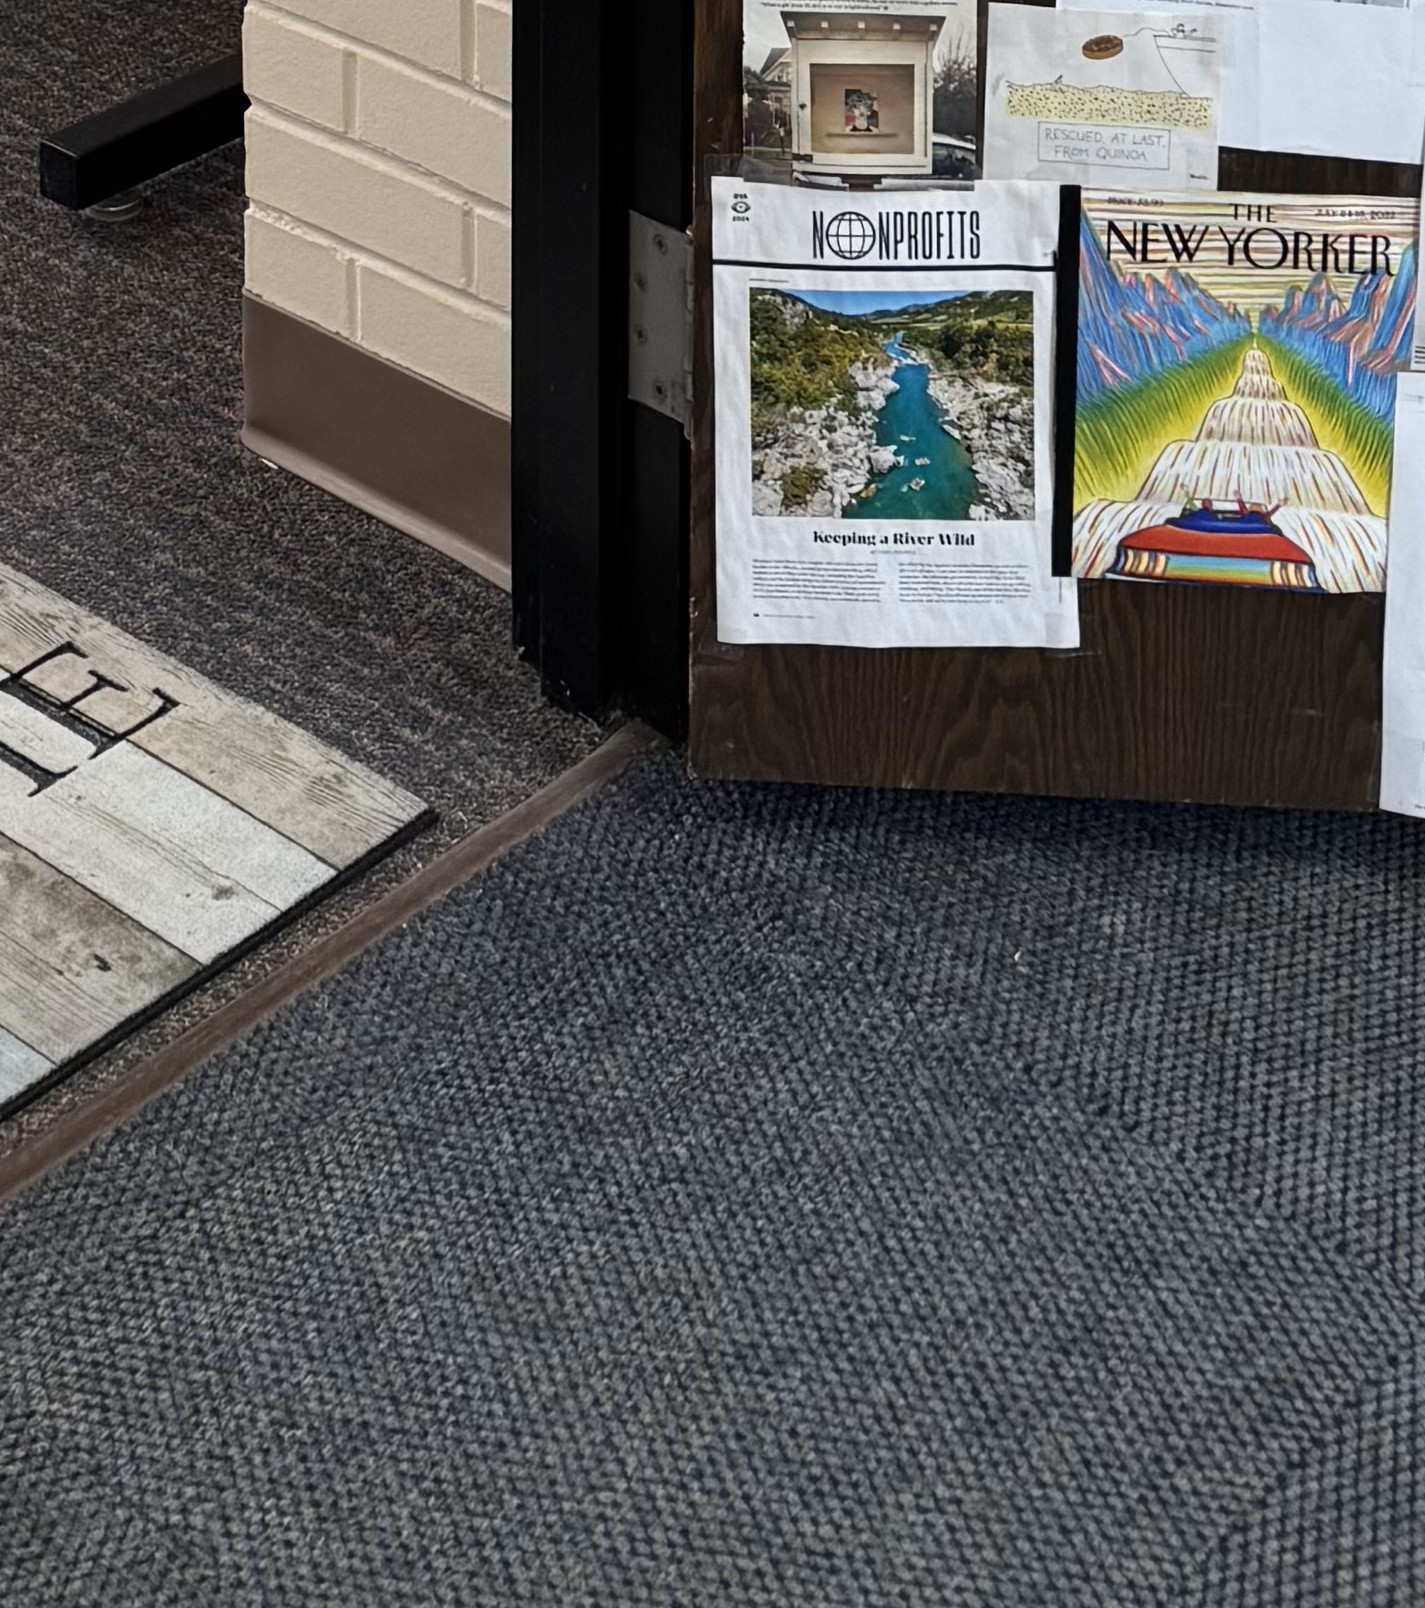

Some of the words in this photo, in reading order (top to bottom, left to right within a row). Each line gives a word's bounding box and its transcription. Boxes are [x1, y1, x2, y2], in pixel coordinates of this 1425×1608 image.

[1054, 145, 1089, 159] FROM
[1096, 147, 1147, 161] QUINOA
[1232, 204, 1277, 223] THE
[1107, 221, 1210, 264] NEW
[1217, 225, 1396, 277] YORKER
[813, 530, 876, 546] Keeping
[893, 532, 934, 544] River
[938, 533, 975, 545] Wild
